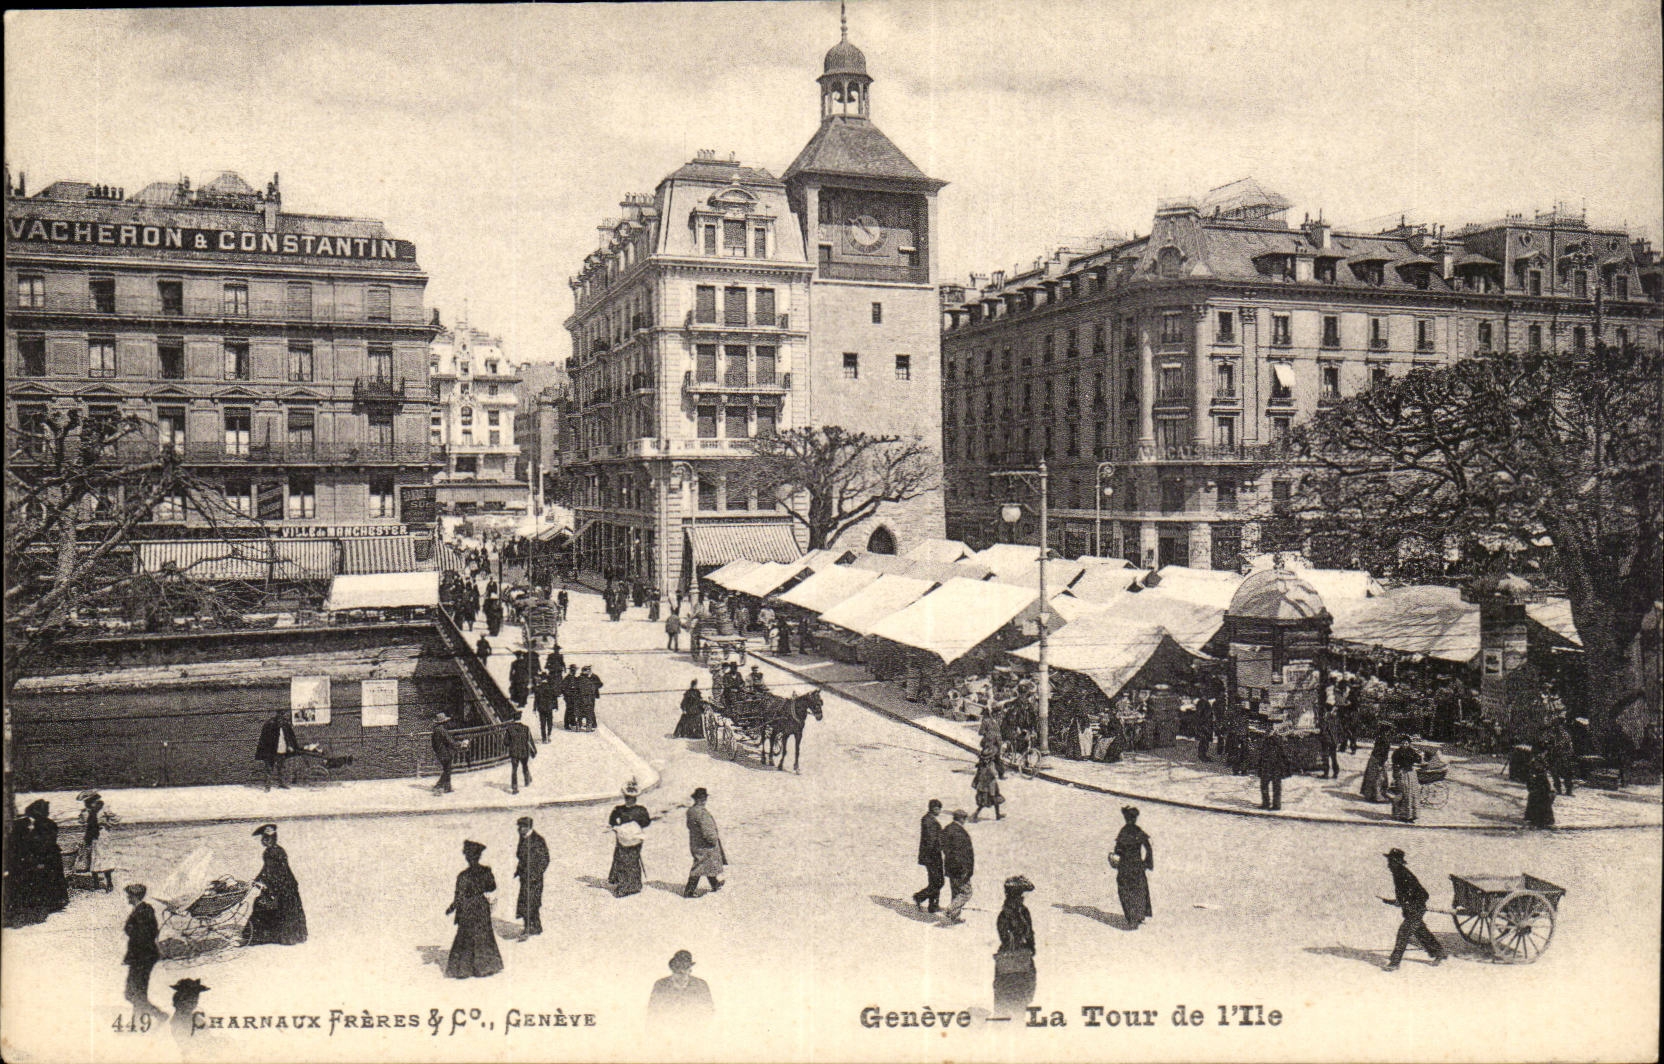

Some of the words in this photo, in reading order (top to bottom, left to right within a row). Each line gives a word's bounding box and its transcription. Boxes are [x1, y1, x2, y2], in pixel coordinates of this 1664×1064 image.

[8, 218, 183, 248] VACHERON
[194, 232, 208, 249] &
[218, 231, 397, 259] CONSTANTIN
[282, 527, 316, 538] VILLE
[327, 525, 408, 537] MANCHESTER
